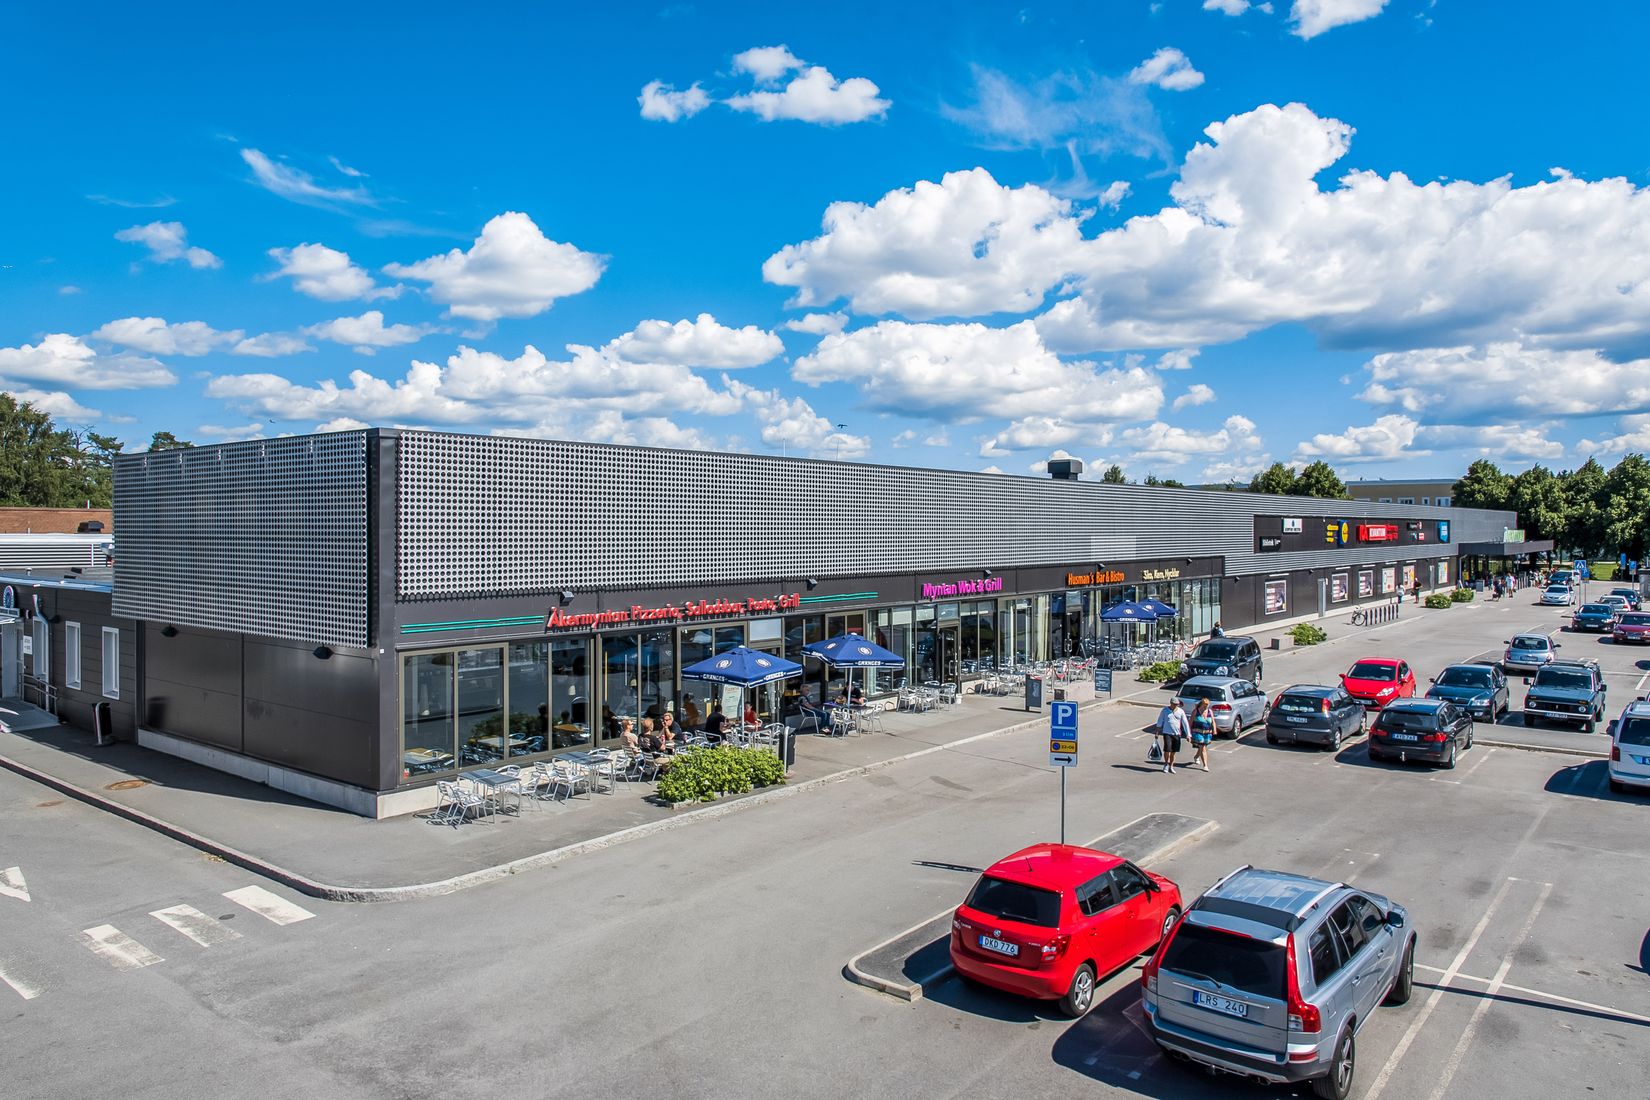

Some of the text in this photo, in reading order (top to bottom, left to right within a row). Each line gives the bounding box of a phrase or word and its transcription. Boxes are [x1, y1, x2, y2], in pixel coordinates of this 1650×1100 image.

[1096, 571, 1105, 584] Bar
[1110, 569, 1125, 582] Bistro
[923, 577, 1002, 599] Myntan Wok & Grill
[546, 592, 800, 630] Åkermyntan Pizzeria, Salladsbar, Pasta, Grill
[1057, 704, 1073, 725] P
[984, 937, 1015, 953] DKD 776
[1199, 993, 1245, 1014] LRS 240
